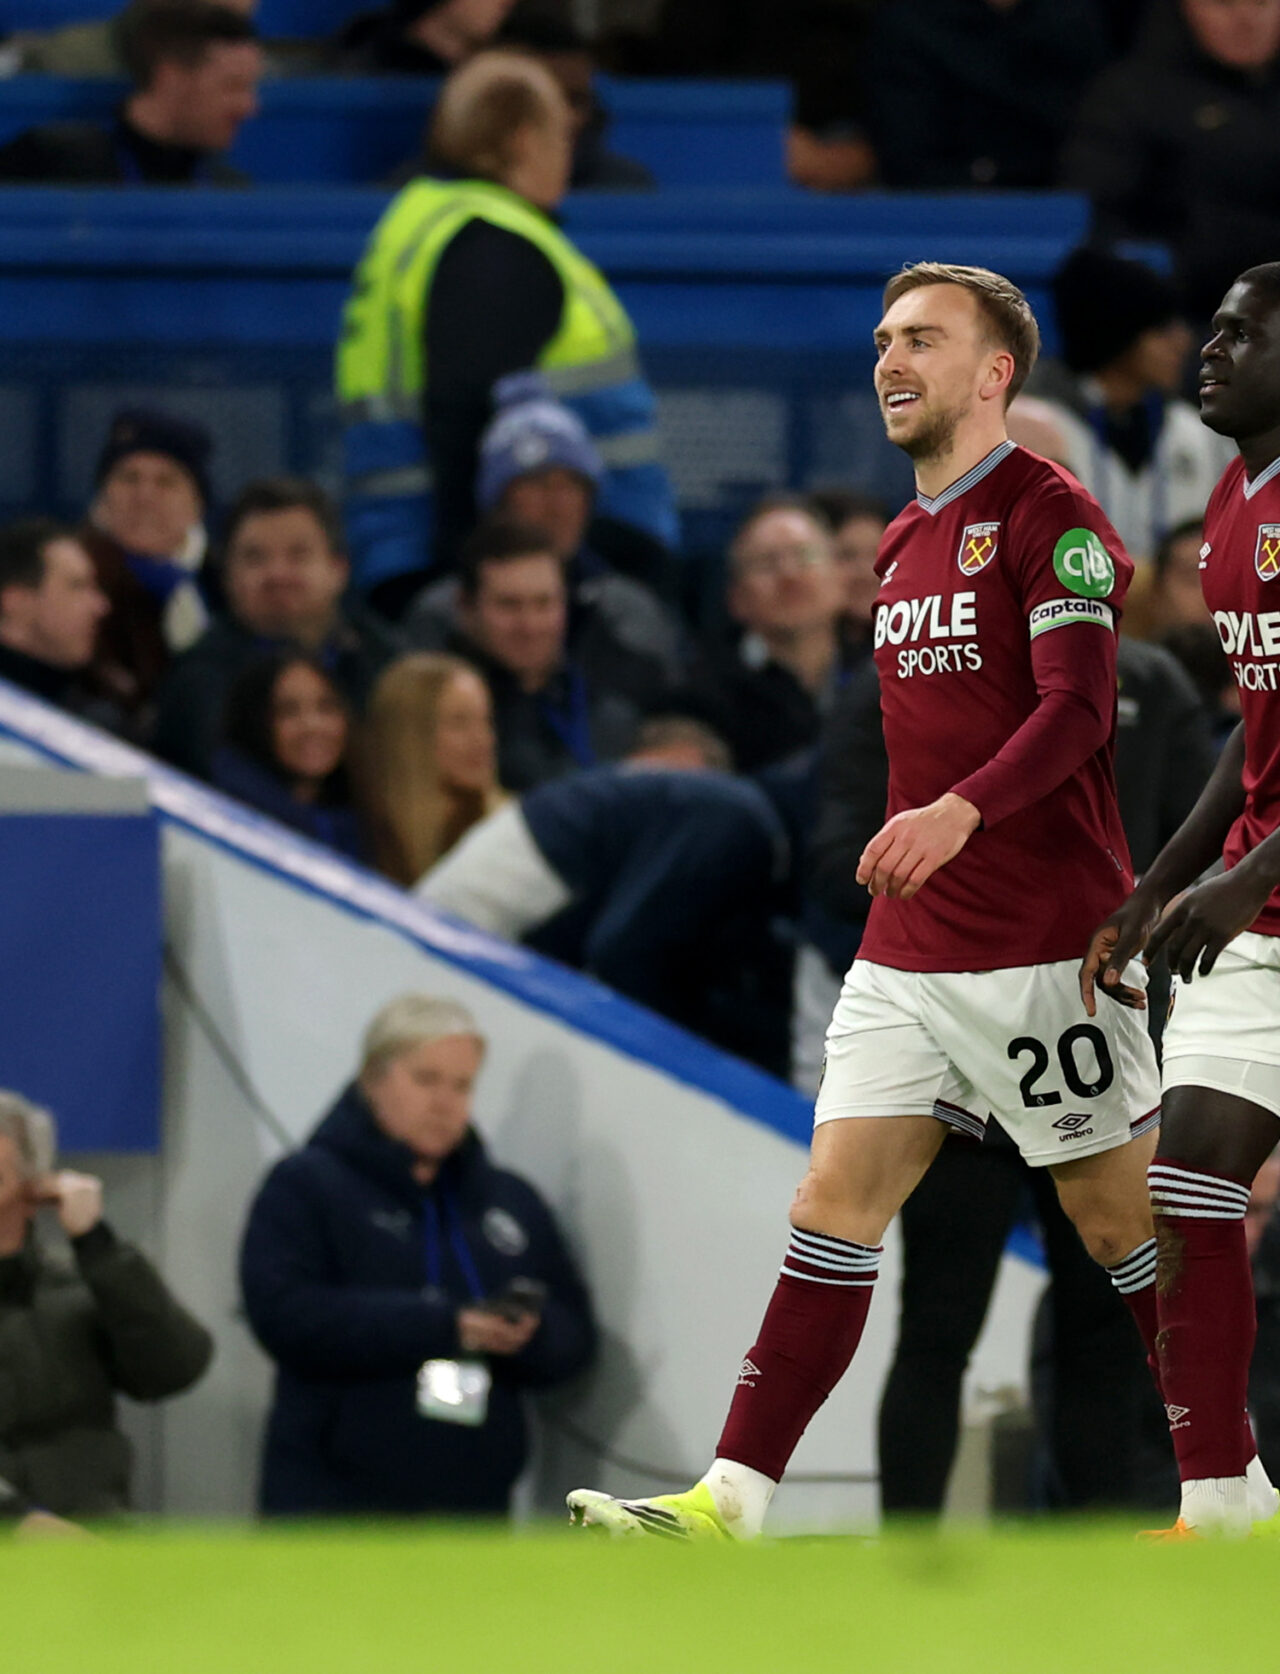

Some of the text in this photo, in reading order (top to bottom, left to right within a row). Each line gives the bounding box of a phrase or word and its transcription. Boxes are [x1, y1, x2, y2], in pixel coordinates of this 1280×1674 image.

[874, 591, 977, 650] BOYLE
[1032, 601, 1103, 623] Captain
[897, 642, 982, 679] SPORTS
[1007, 1023, 1114, 1108] 20
[1059, 1127, 1094, 1142] umbro
